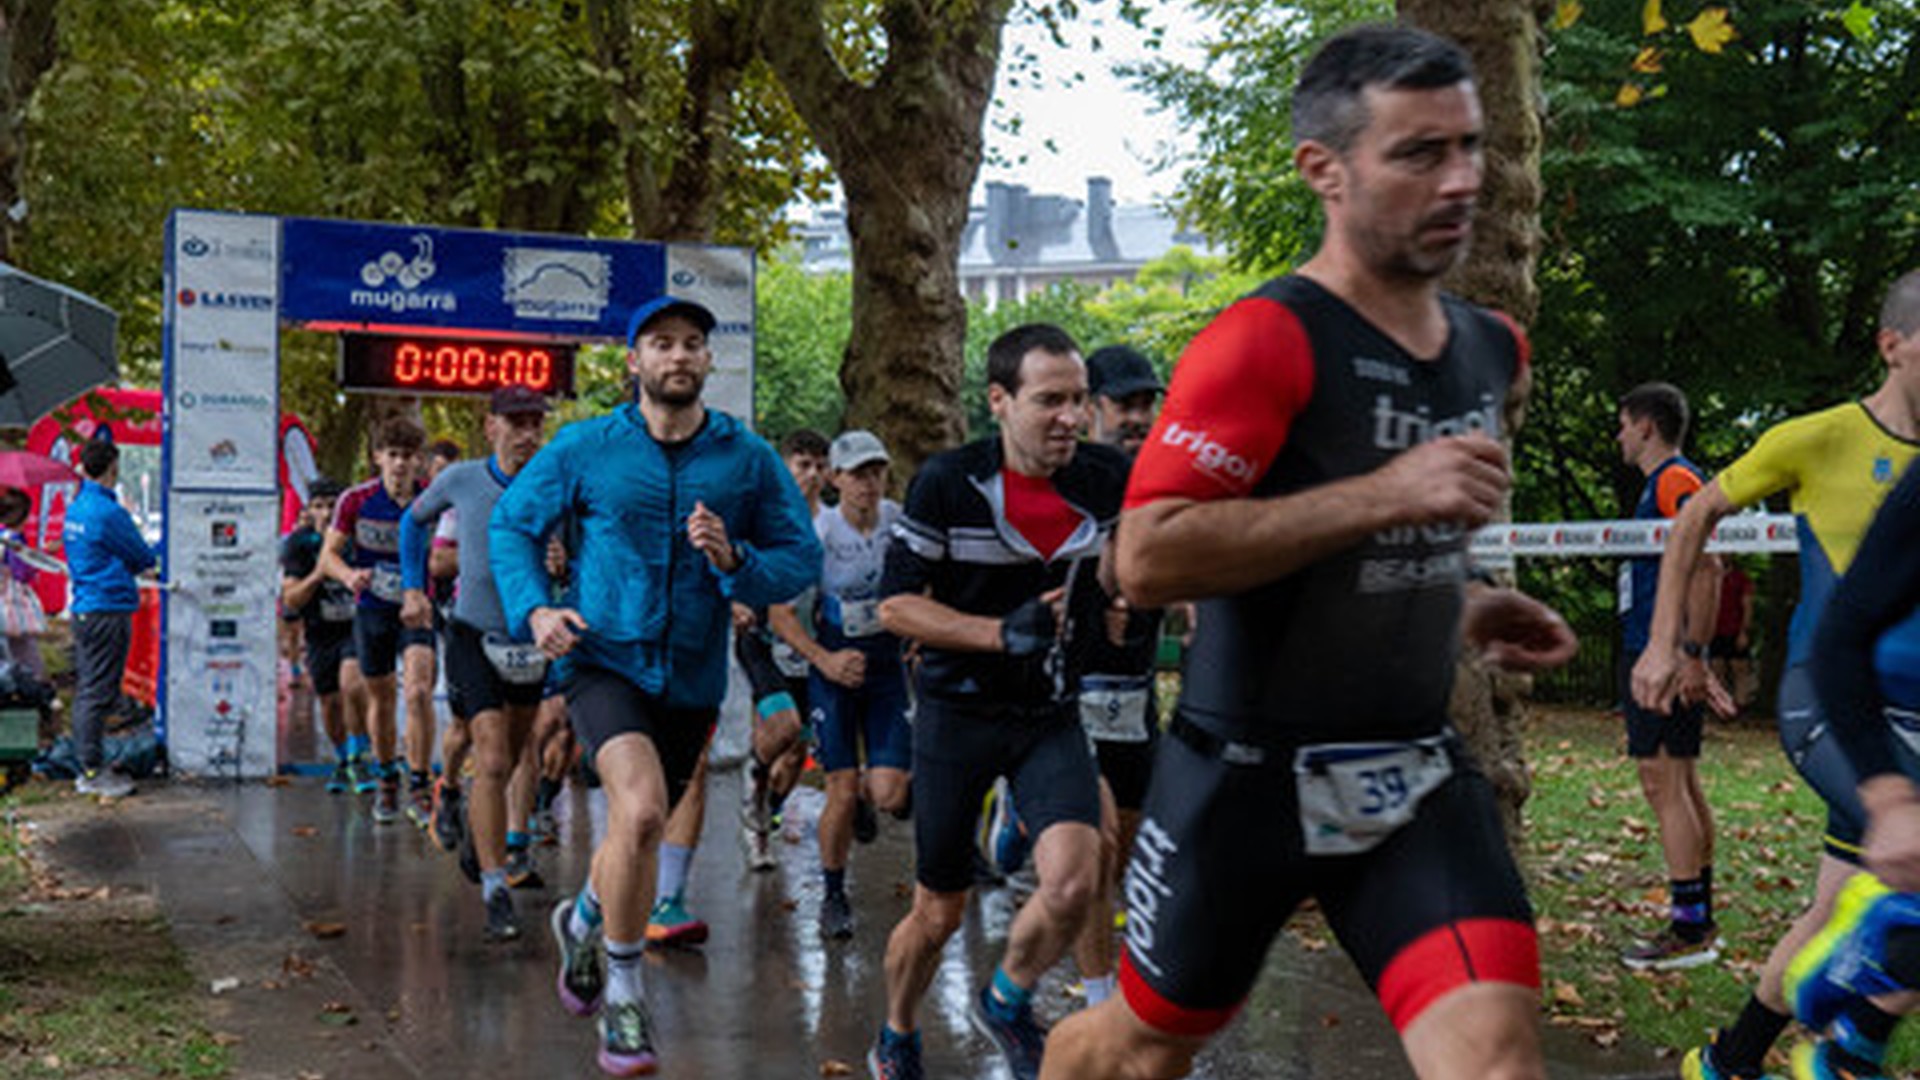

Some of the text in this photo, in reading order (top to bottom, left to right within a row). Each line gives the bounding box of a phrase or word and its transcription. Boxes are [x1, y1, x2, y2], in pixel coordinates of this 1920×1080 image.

[201, 290, 272, 312] LASVEN
[350, 288, 457, 313] mugarra
[394, 342, 550, 389] 0:00:00
[1357, 765, 1409, 815] 39
